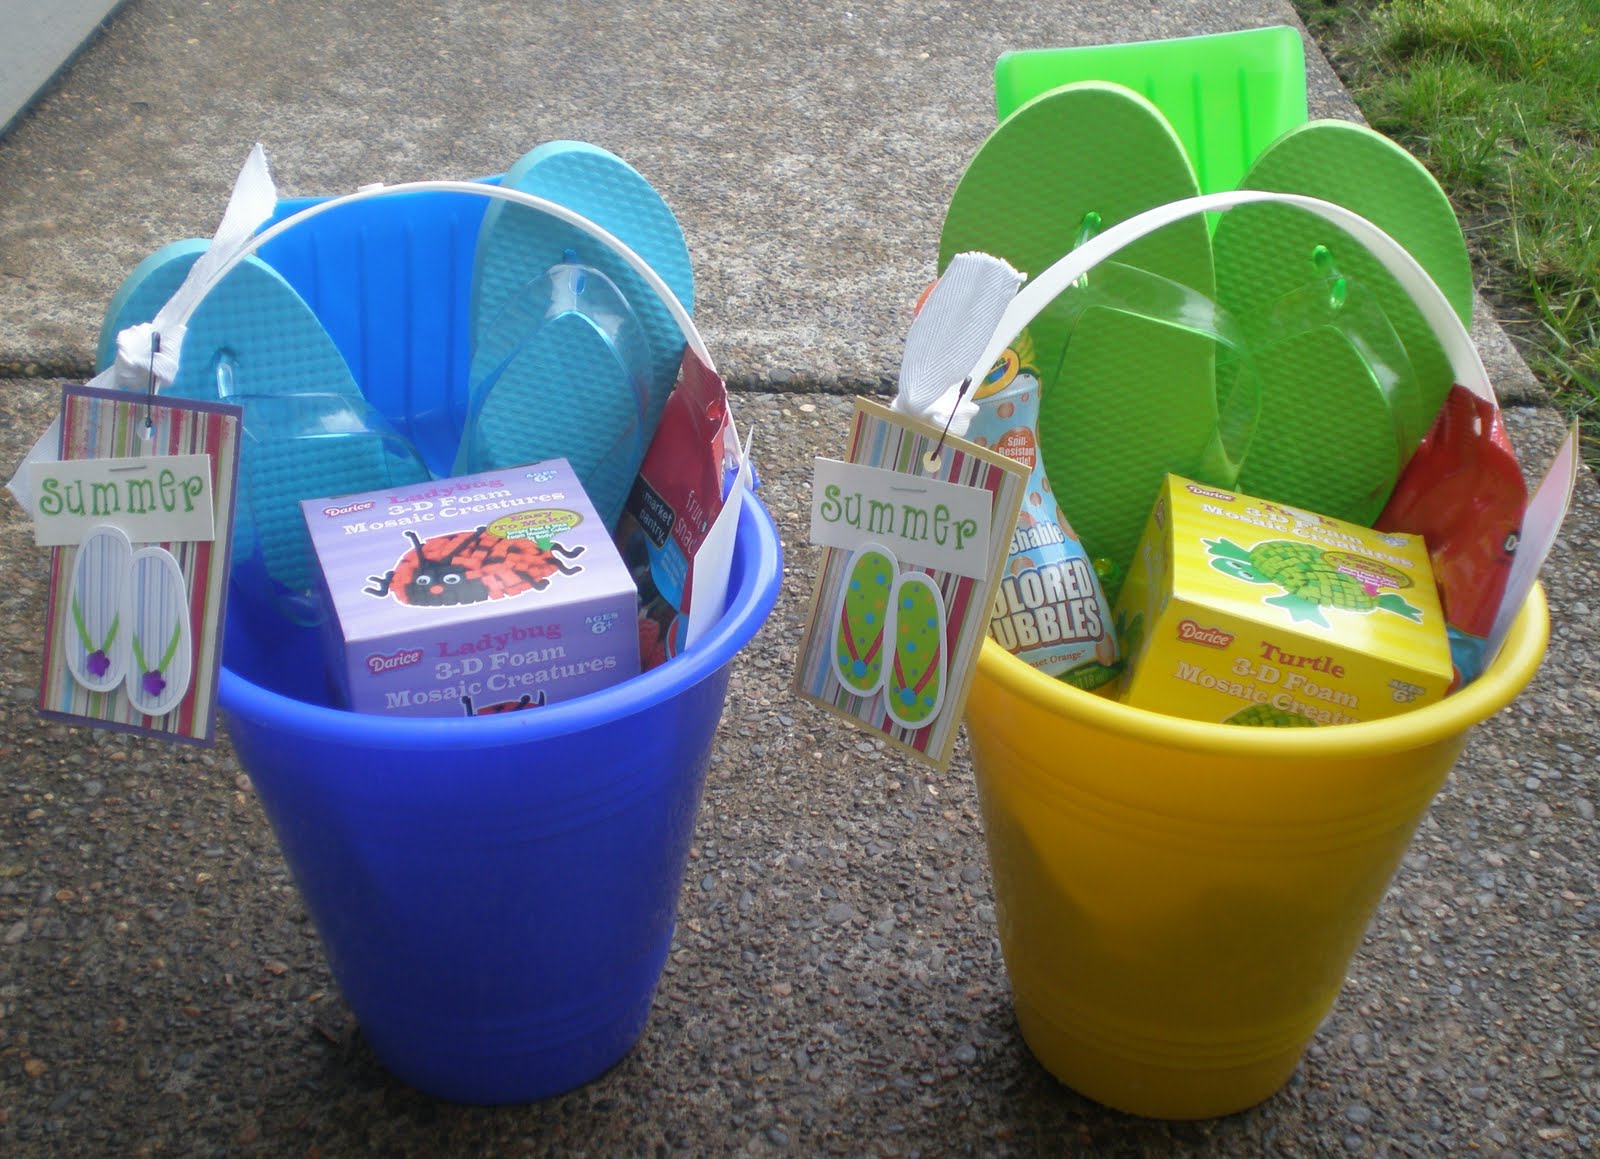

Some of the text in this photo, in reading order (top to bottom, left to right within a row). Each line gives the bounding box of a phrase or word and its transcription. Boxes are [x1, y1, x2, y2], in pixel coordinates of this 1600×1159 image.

[1007, 436, 1028, 446] Spill-
[39, 468, 203, 516] Summer
[325, 501, 372, 516] Darice
[386, 479, 505, 504] Ladybug
[388, 489, 512, 516] 3-D Foam
[644, 492, 673, 526] market
[1190, 485, 1233, 500] Darice
[342, 492, 565, 535] Mosaic Creatures
[511, 511, 553, 521] Easy
[522, 514, 575, 527] Make!
[820, 484, 978, 550] Summer
[1246, 506, 1290, 524] 3-D
[1293, 516, 1363, 546] Foam
[1009, 520, 1065, 556] shable
[1202, 503, 1289, 533] Mosaic
[1291, 527, 1414, 568] Creatures
[992, 558, 1094, 620] OLORED
[584, 612, 619, 624] AGES
[591, 620, 613, 634] 6+
[992, 596, 1102, 651] UBBLES
[1181, 623, 1229, 645] Darice
[436, 623, 561, 658] Ladybug
[369, 653, 419, 672] Darice
[435, 645, 567, 680] 3-D Foam
[1260, 641, 1346, 679] Turtle
[385, 655, 617, 709] Mosaic Creatures
[1174, 660, 1269, 705] Mosaic
[1232, 657, 1360, 710] 3-D Foam
